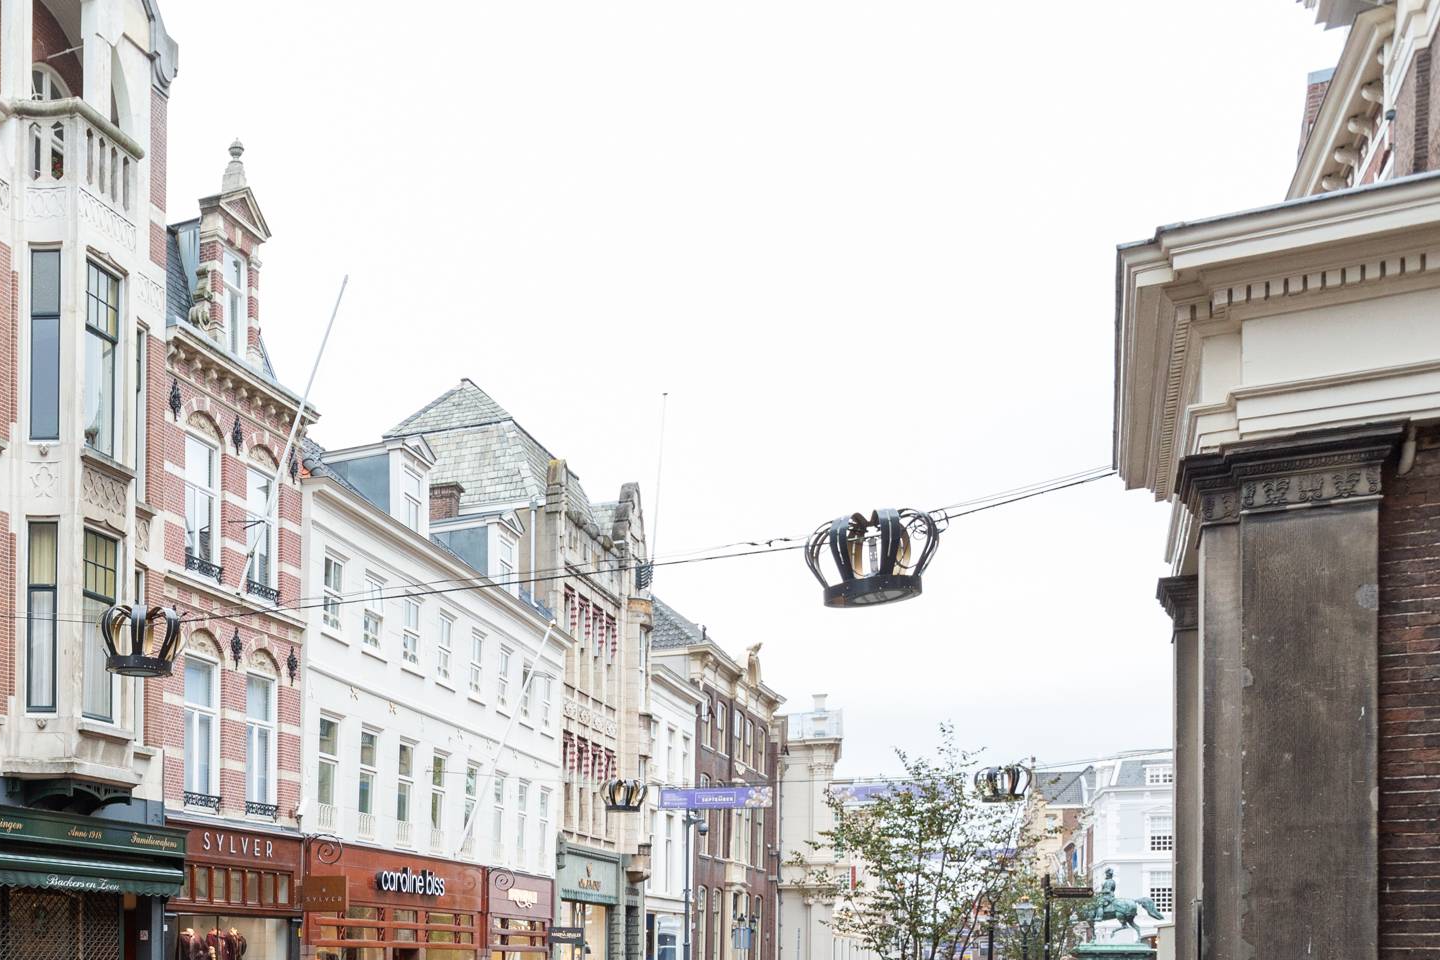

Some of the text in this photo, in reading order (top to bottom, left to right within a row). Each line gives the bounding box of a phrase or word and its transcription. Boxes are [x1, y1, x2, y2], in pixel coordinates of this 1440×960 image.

[67, 826, 103, 840] Anno 1918
[203, 831, 274, 858] SYLVER
[46, 874, 85, 888] Backers
[381, 866, 446, 897] caroline biss
